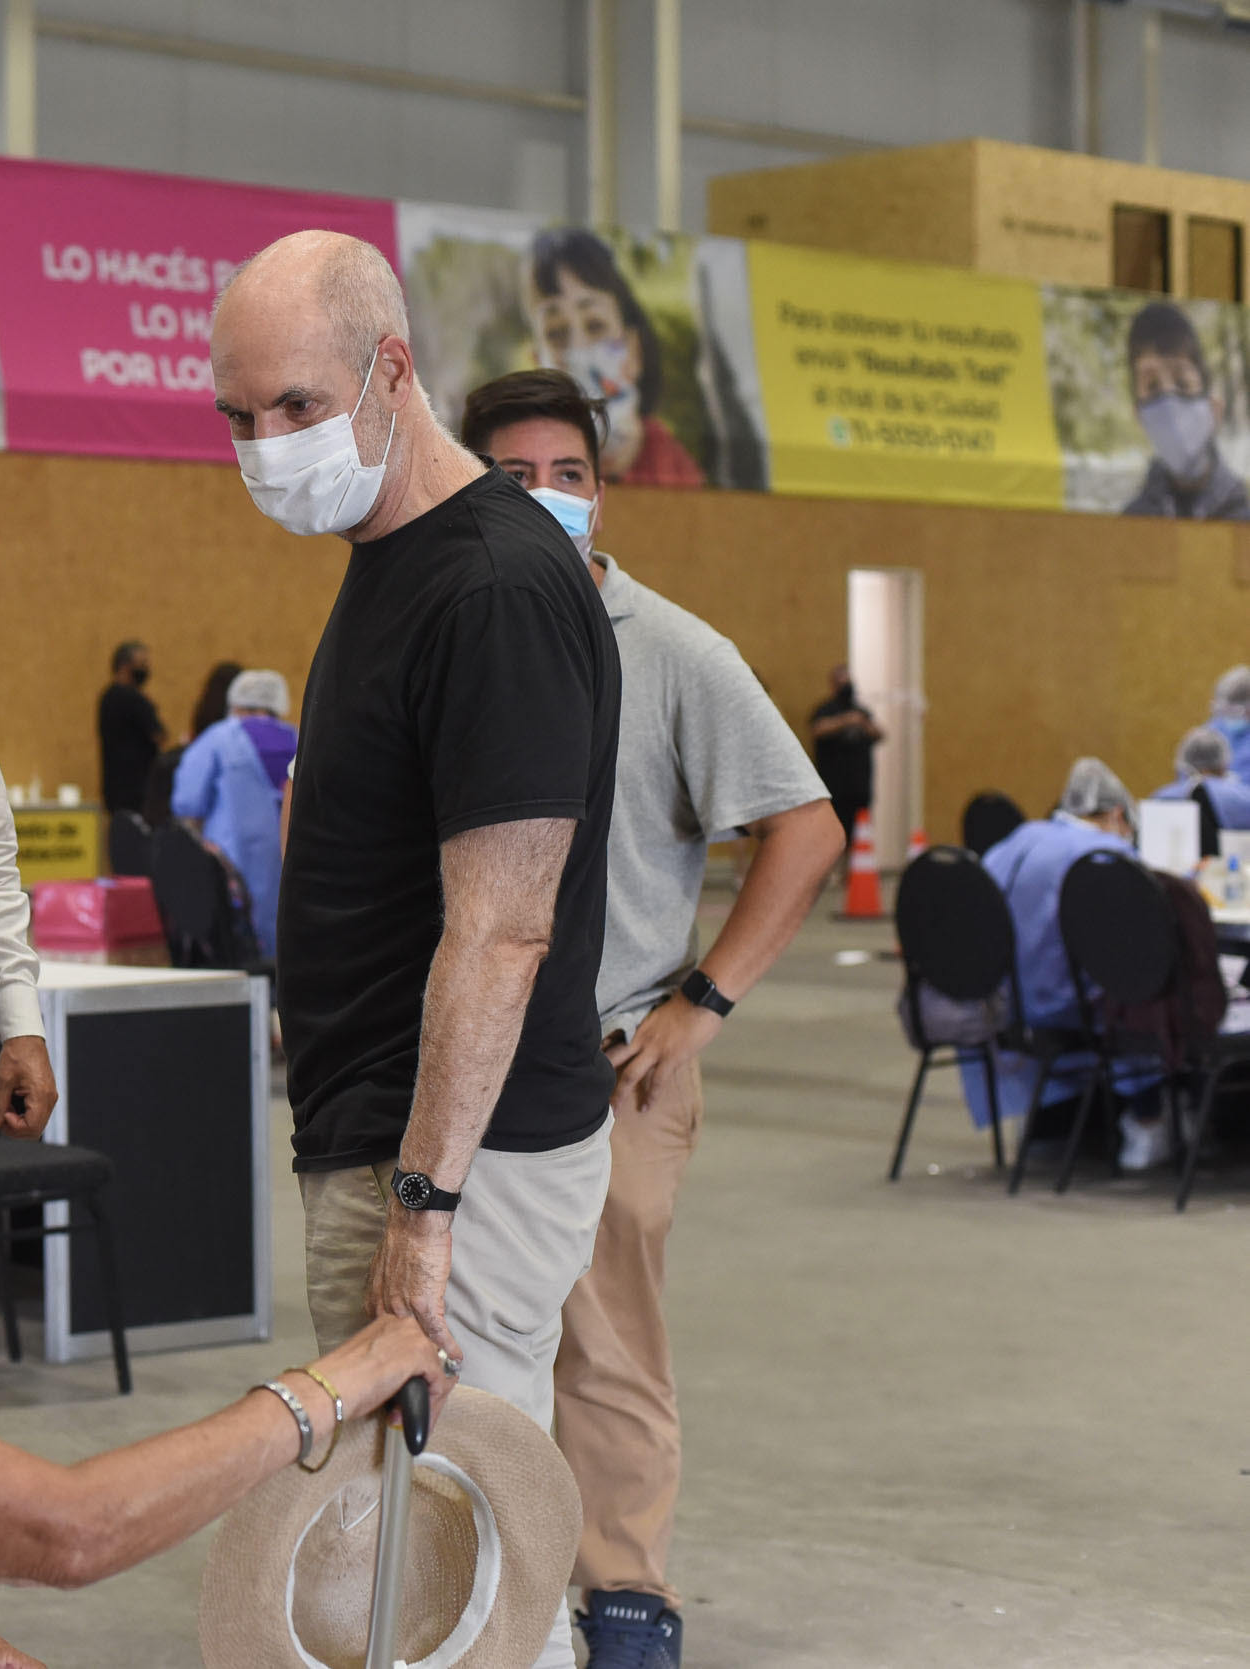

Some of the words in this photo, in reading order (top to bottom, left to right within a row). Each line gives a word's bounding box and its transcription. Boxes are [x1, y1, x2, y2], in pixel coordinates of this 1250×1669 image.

[41, 244, 91, 282] LO
[96, 246, 209, 293] HACÉS
[129, 301, 177, 341] LO
[777, 300, 824, 333] Para
[80, 347, 158, 388] POR
